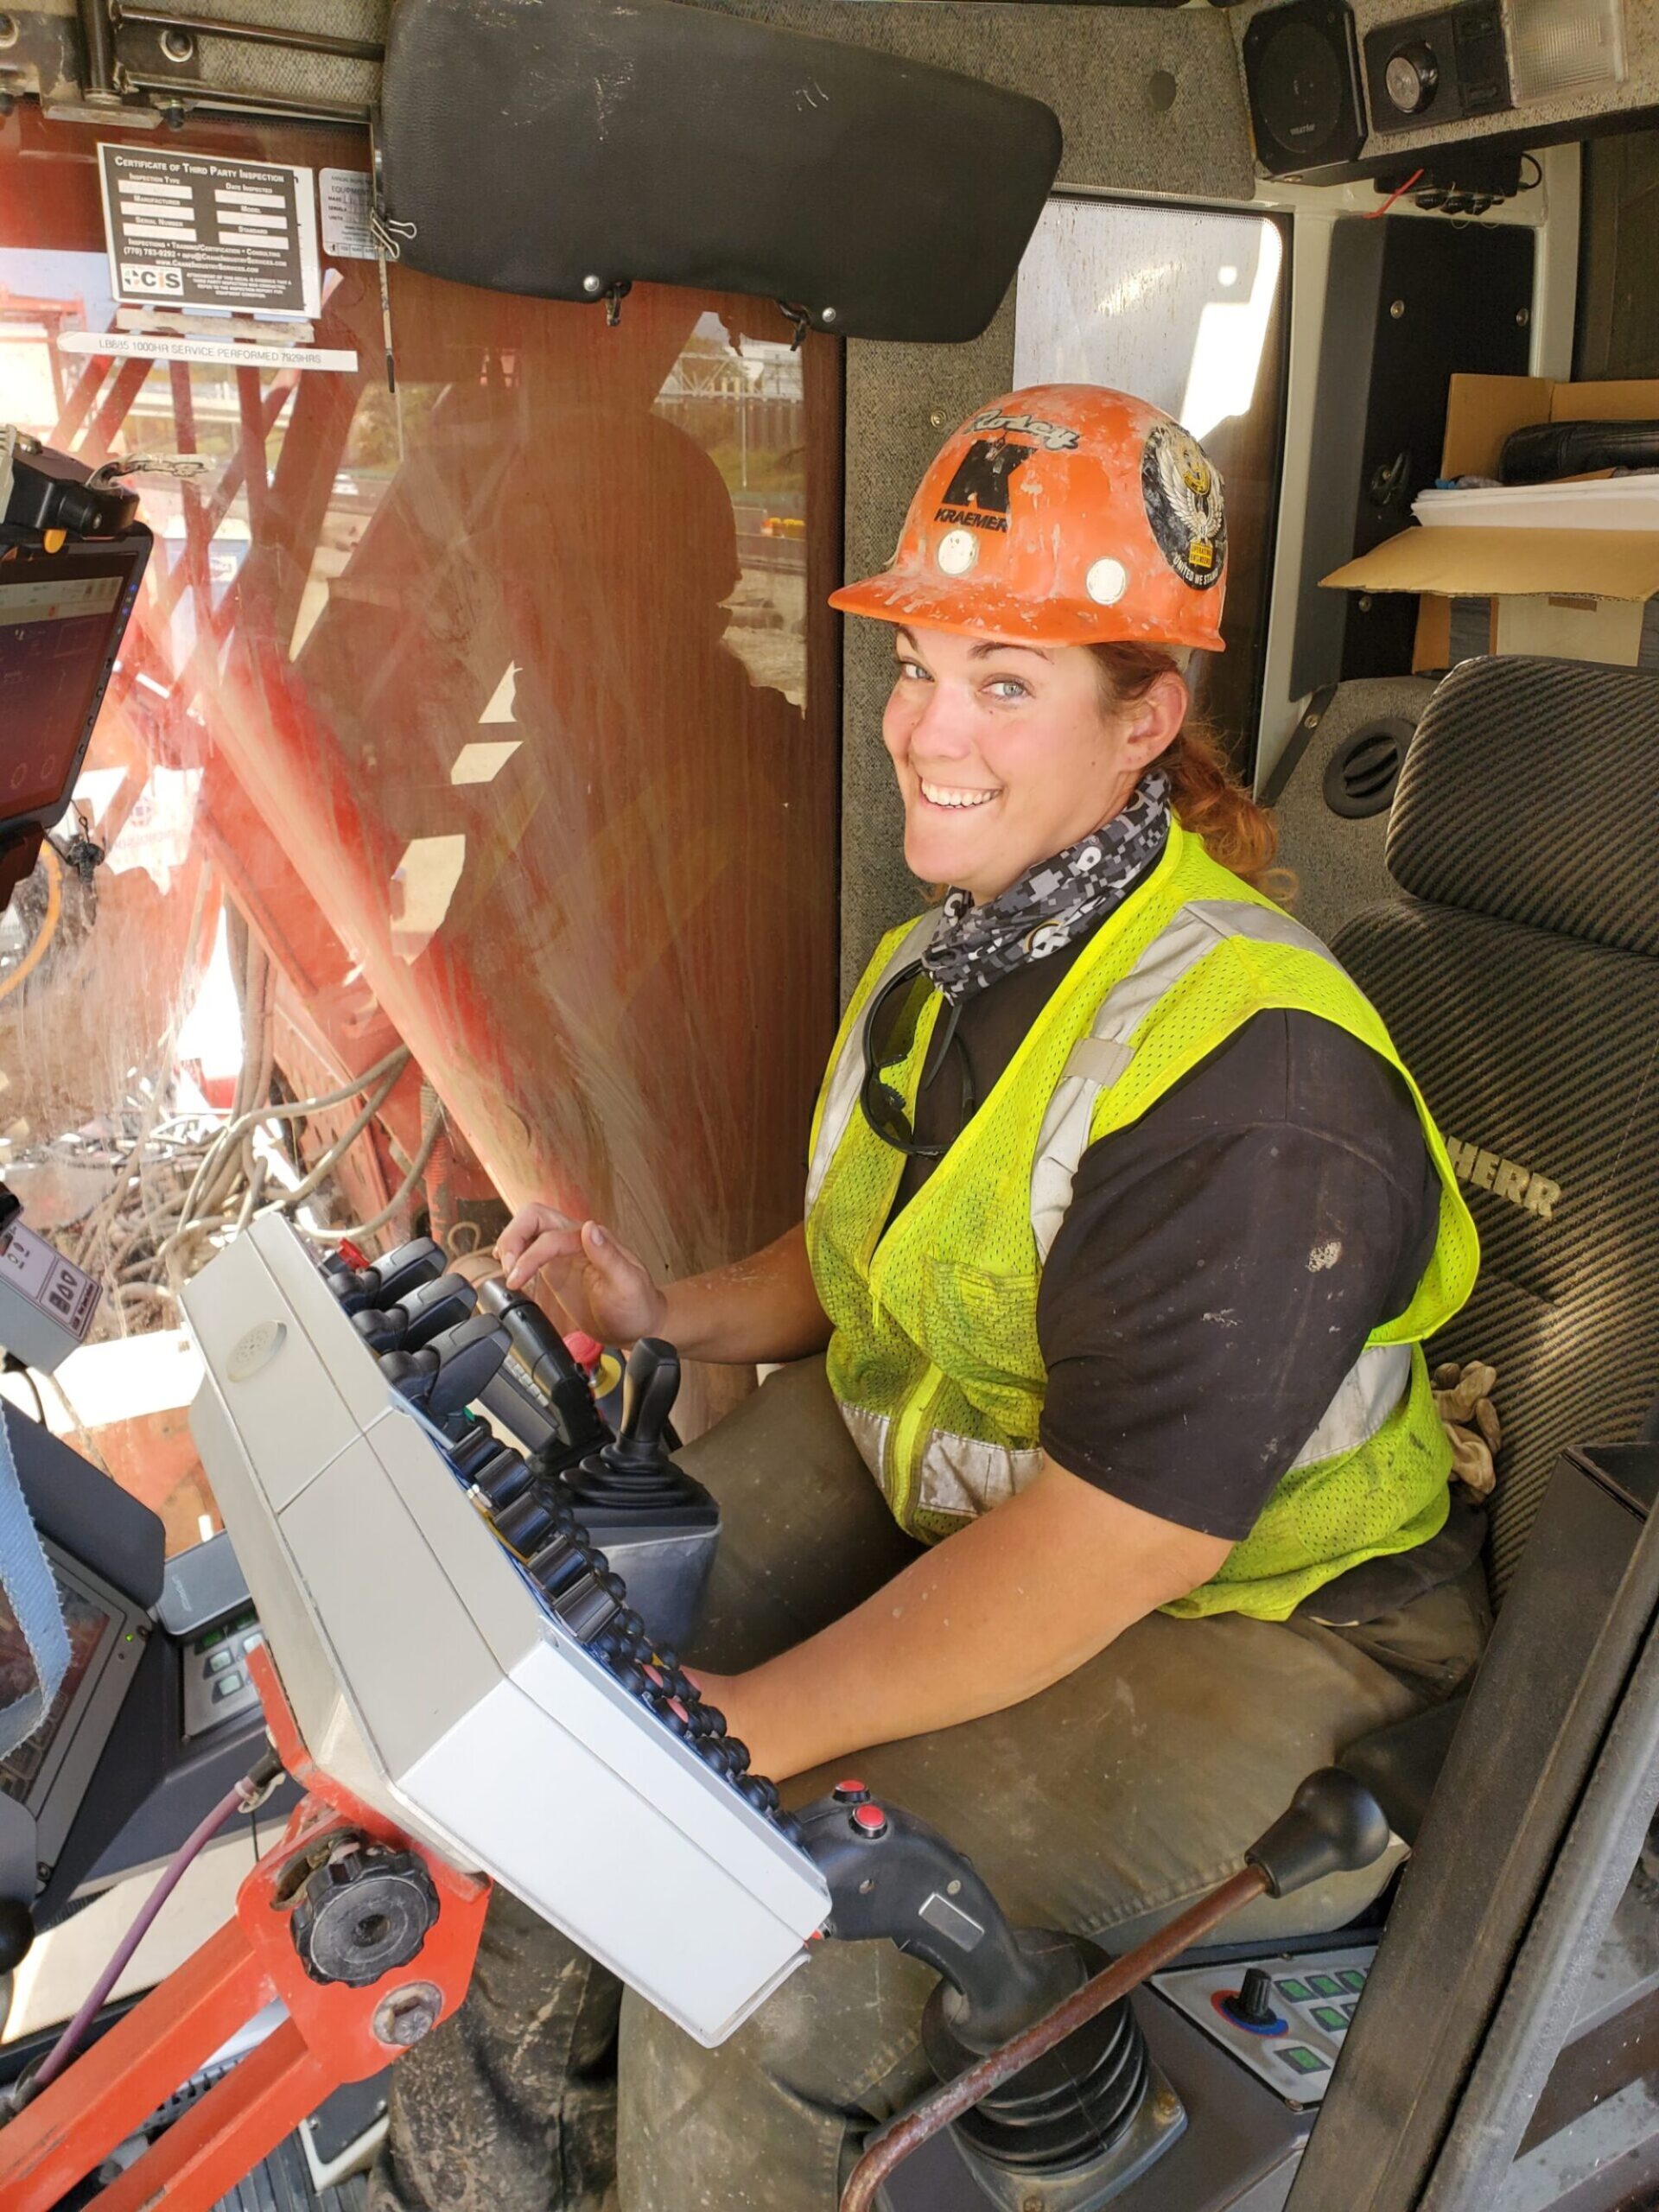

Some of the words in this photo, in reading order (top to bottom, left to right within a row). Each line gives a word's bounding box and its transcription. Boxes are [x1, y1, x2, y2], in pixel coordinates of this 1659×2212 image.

[115, 156, 168, 170] CERTIFICATE
[169, 163, 181, 172] OF
[182, 162, 208, 175] THIRD
[210, 165, 237, 178] PARTY
[239, 169, 284, 183] INSPECTION
[132, 340, 168, 353] 1000HR
[172, 344, 215, 357] SERVICE
[217, 347, 279, 361] PERFORMED
[934, 508, 1008, 533] KRAEMER
[1173, 552, 1195, 582] UNITED
[1194, 574, 1204, 586] WE
[1441, 1133, 1561, 1220] HERR
